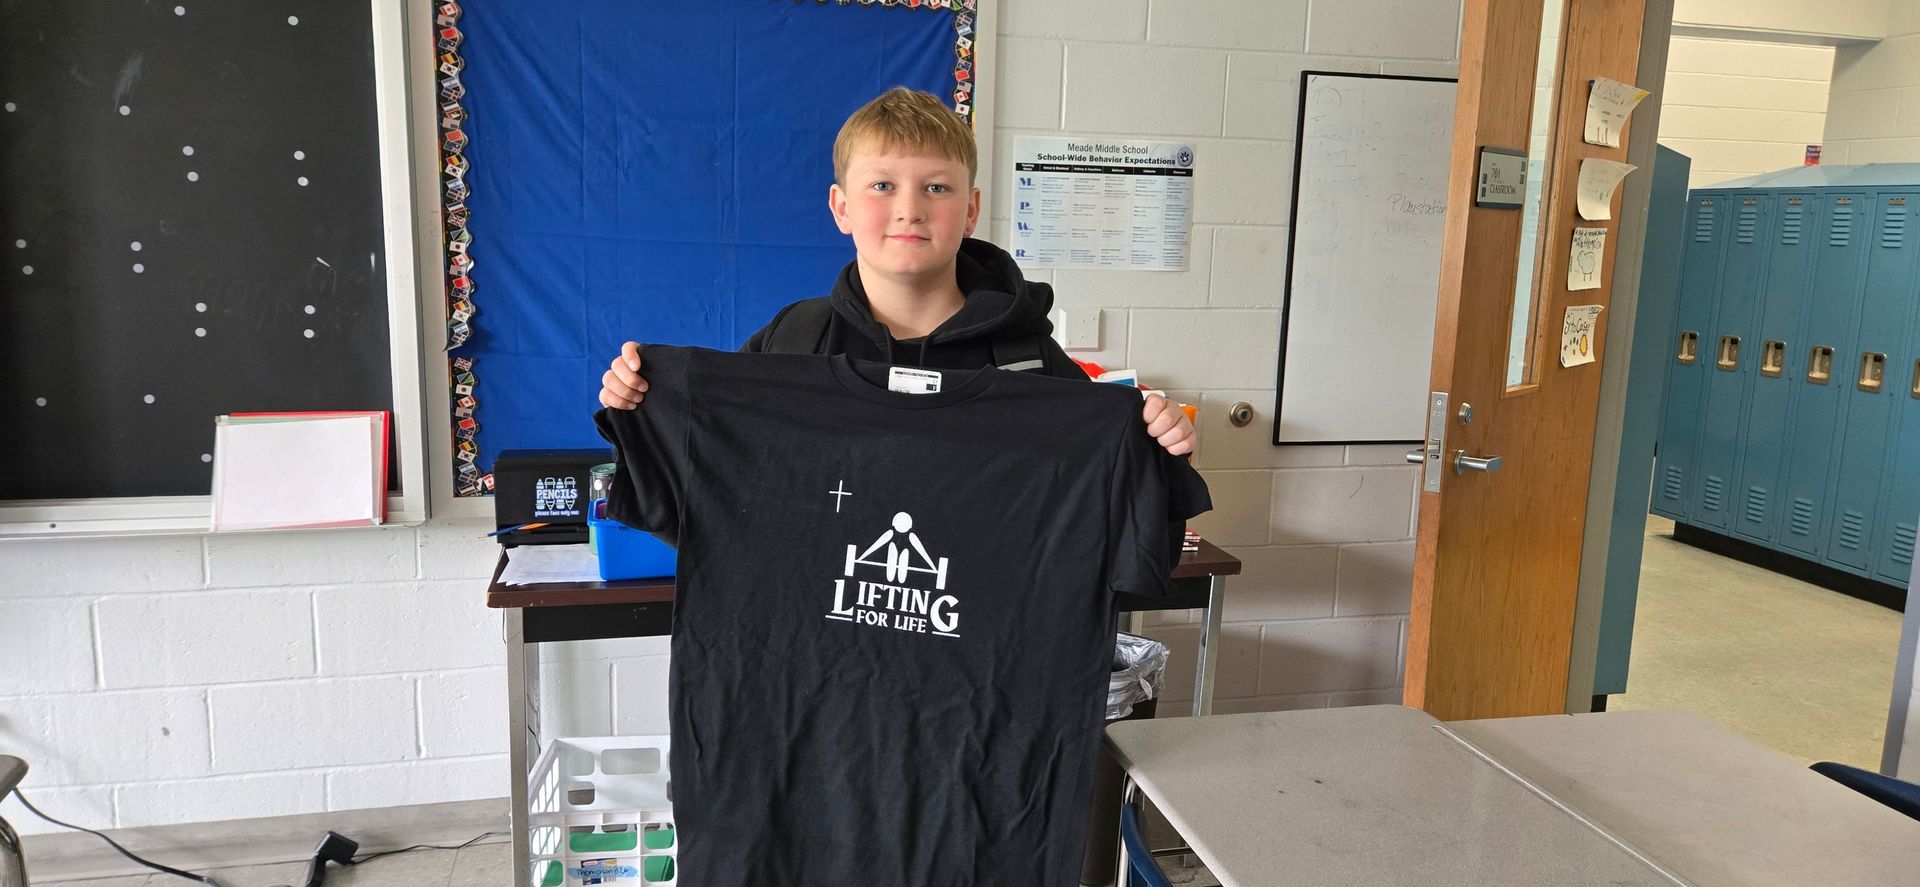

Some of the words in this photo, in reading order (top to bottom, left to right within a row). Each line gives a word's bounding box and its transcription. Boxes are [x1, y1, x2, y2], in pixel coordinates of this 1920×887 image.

[1067, 143, 1093, 152] Meade
[1095, 144, 1121, 154] Middle
[1122, 145, 1149, 155] School
[1037, 153, 1087, 162] School-Wide
[1089, 155, 1123, 163] Behavior
[1124, 156, 1176, 166] Expectations
[536, 489, 577, 499] PENCILS
[831, 579, 959, 632] LIFTING
[855, 609, 888, 627] FOR
[894, 614, 927, 633] LIFE
